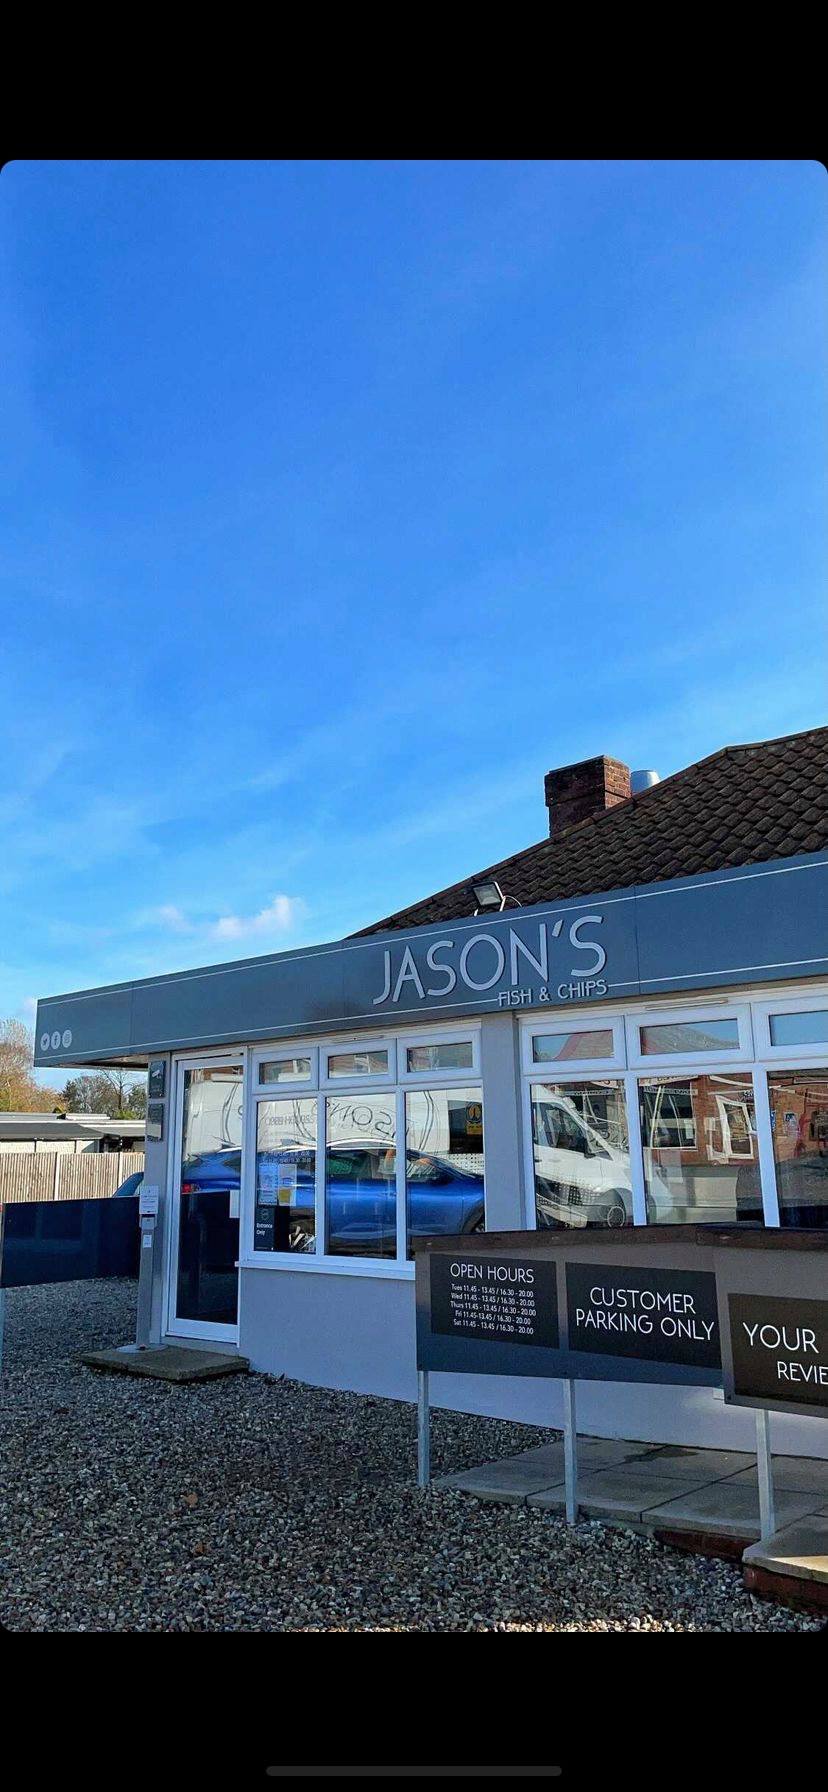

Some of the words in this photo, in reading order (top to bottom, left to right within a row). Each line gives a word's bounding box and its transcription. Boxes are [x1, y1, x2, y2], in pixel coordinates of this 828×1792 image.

[372, 915, 608, 1005] JASON'S
[498, 990, 532, 1006] FISH
[539, 990, 550, 1002] &
[558, 979, 608, 999] CHIPS
[450, 1263, 483, 1278] OPEN
[488, 1266, 534, 1283] HOURS
[590, 1286, 696, 1314] CUSTOMER
[576, 1309, 653, 1334] PARKING
[660, 1317, 715, 1341] ONLY
[742, 1322, 820, 1354] YOUR
